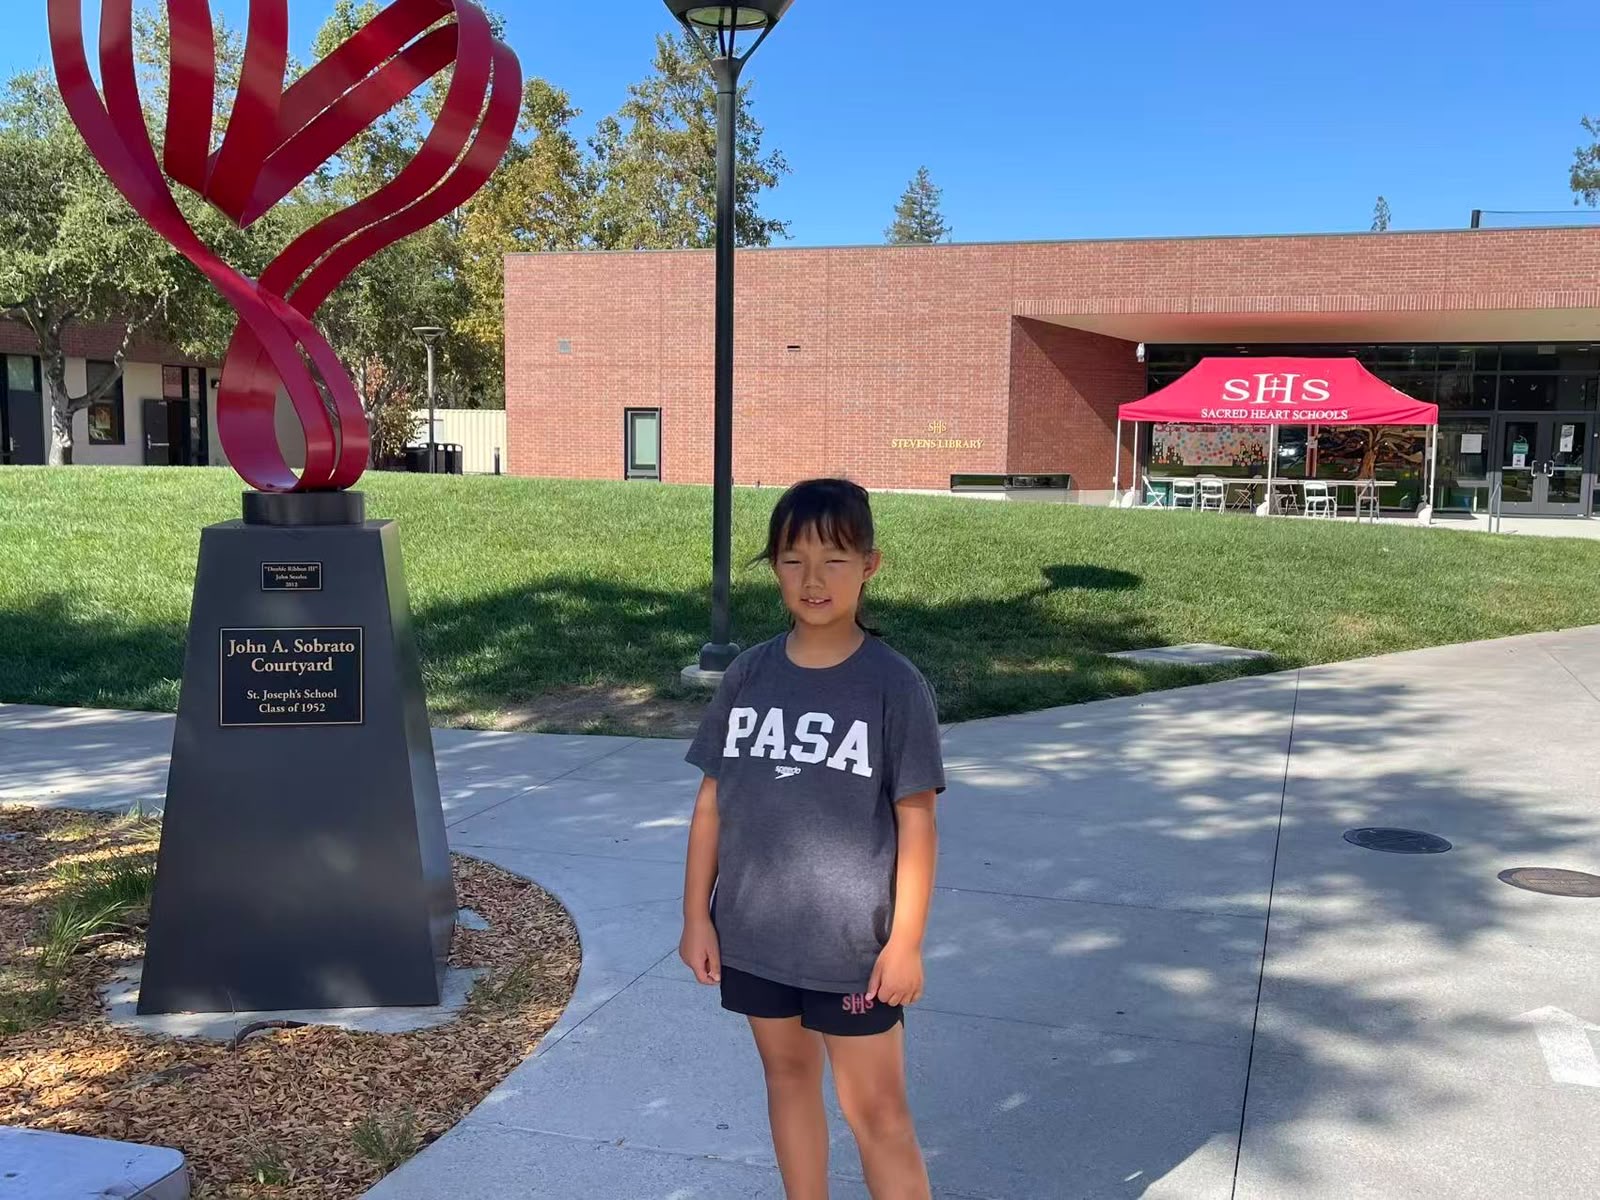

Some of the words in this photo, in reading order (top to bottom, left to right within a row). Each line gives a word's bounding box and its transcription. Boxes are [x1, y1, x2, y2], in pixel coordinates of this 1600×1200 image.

[1221, 373, 1331, 404] SHS
[1201, 408, 1248, 419] SACRED
[1251, 409, 1290, 420] HEART
[1292, 409, 1348, 420] SCHOOLS
[891, 438, 937, 449] STEVENS
[939, 439, 983, 449] LIBRARY
[227, 639, 267, 656] John
[272, 639, 288, 653] A.
[293, 638, 355, 653] Sobrato
[251, 657, 333, 675] Courtyard
[246, 690, 260, 700] St.
[303, 688, 337, 699] School
[258, 704, 286, 713] Class
[288, 703, 300, 712] of
[301, 703, 326, 712] 1952
[723, 707, 873, 778] PASA
